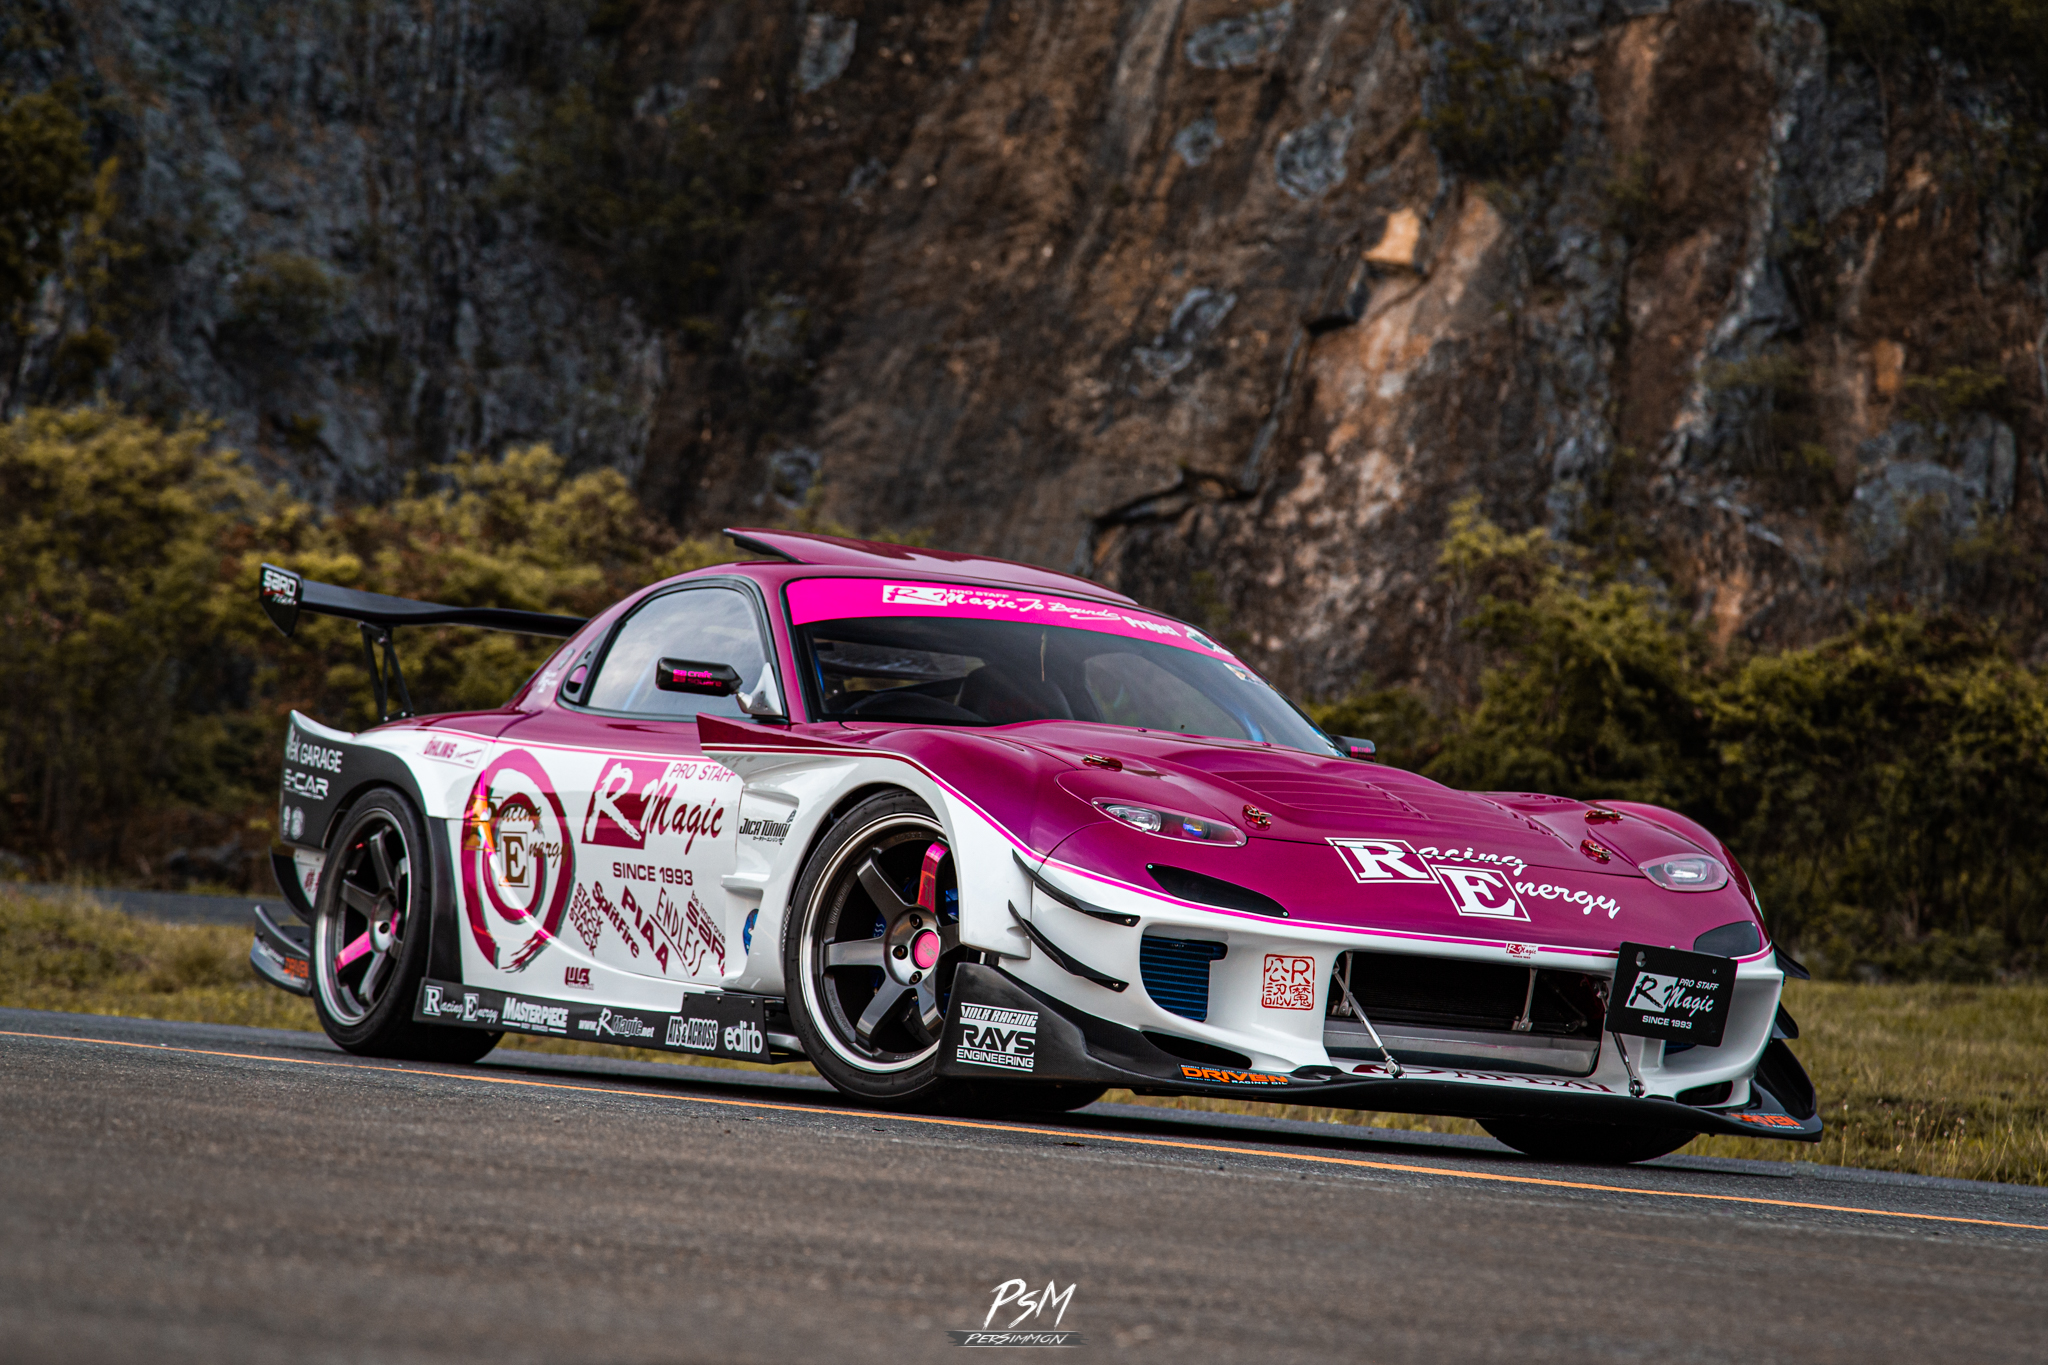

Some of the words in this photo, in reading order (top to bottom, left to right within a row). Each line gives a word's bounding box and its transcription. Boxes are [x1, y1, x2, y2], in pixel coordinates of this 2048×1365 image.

[688, 670, 712, 679] craft
[300, 743, 343, 773] GARAGE
[669, 763, 697, 779] PRO
[698, 765, 736, 782] STAFF
[761, 820, 791, 838] TUNIN
[613, 862, 656, 882] SINCE
[659, 867, 693, 886] 1993
[1330, 838, 1528, 882] Racing
[1434, 866, 1620, 921] Energy
[572, 895, 601, 945] STACK
[577, 882, 604, 933] STACK
[592, 881, 640, 959] SplitFire
[569, 907, 597, 957] STACK
[621, 885, 669, 975] PIAA
[656, 887, 706, 977] ENDLESS
[1679, 979, 1695, 987] PRO
[1696, 981, 1719, 991] STAFF
[502, 997, 569, 1028] MASTERPIECE
[961, 1006, 991, 1021] VOLK
[990, 1010, 1038, 1027] RACING
[1642, 1015, 1670, 1026] SINCE
[1671, 1019, 1692, 1029] 1993
[724, 1021, 763, 1054] edirb
[959, 1023, 1036, 1056] RAYS
[956, 1048, 1034, 1068] ENGINEERING
[1181, 1067, 1288, 1083] DRIVEN
